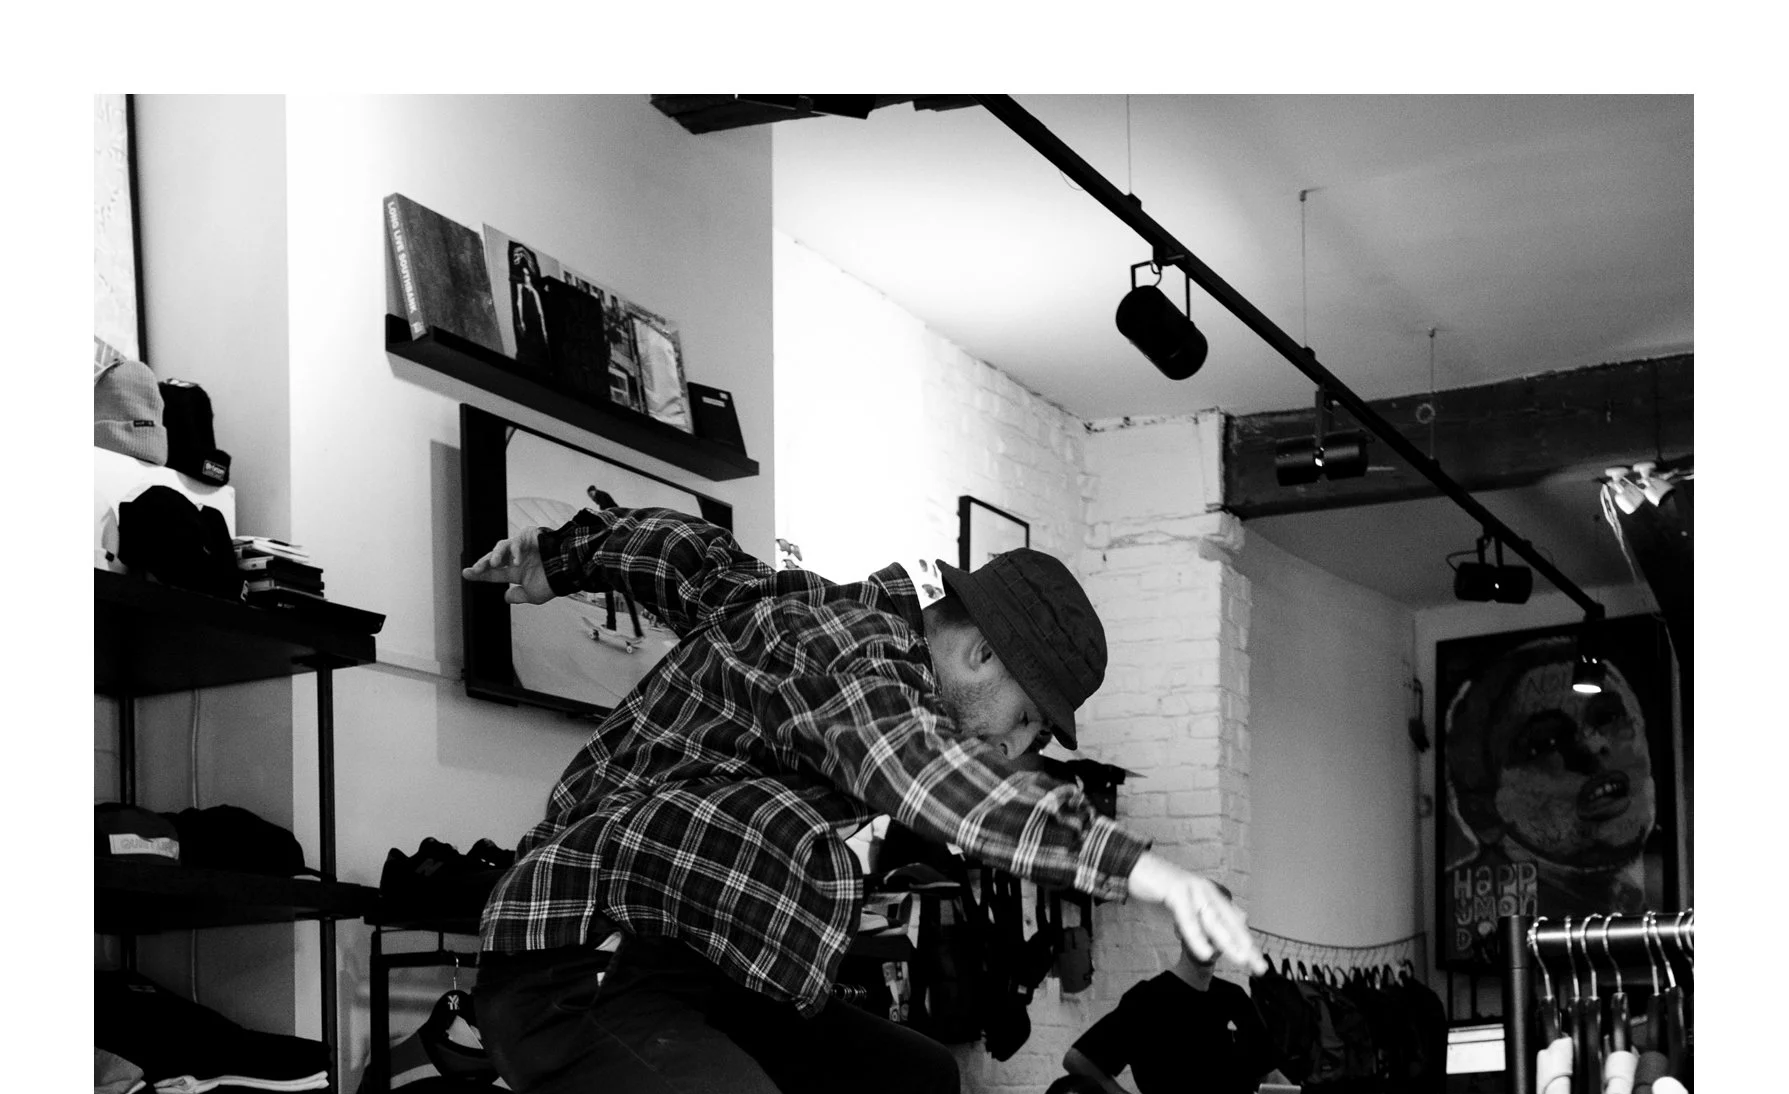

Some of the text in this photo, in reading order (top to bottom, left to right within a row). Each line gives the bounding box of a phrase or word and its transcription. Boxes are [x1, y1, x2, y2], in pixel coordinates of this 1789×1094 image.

[387, 201, 399, 229] LONG
[392, 229, 404, 253] LIVE
[397, 252, 418, 313] SOUTHBANK
